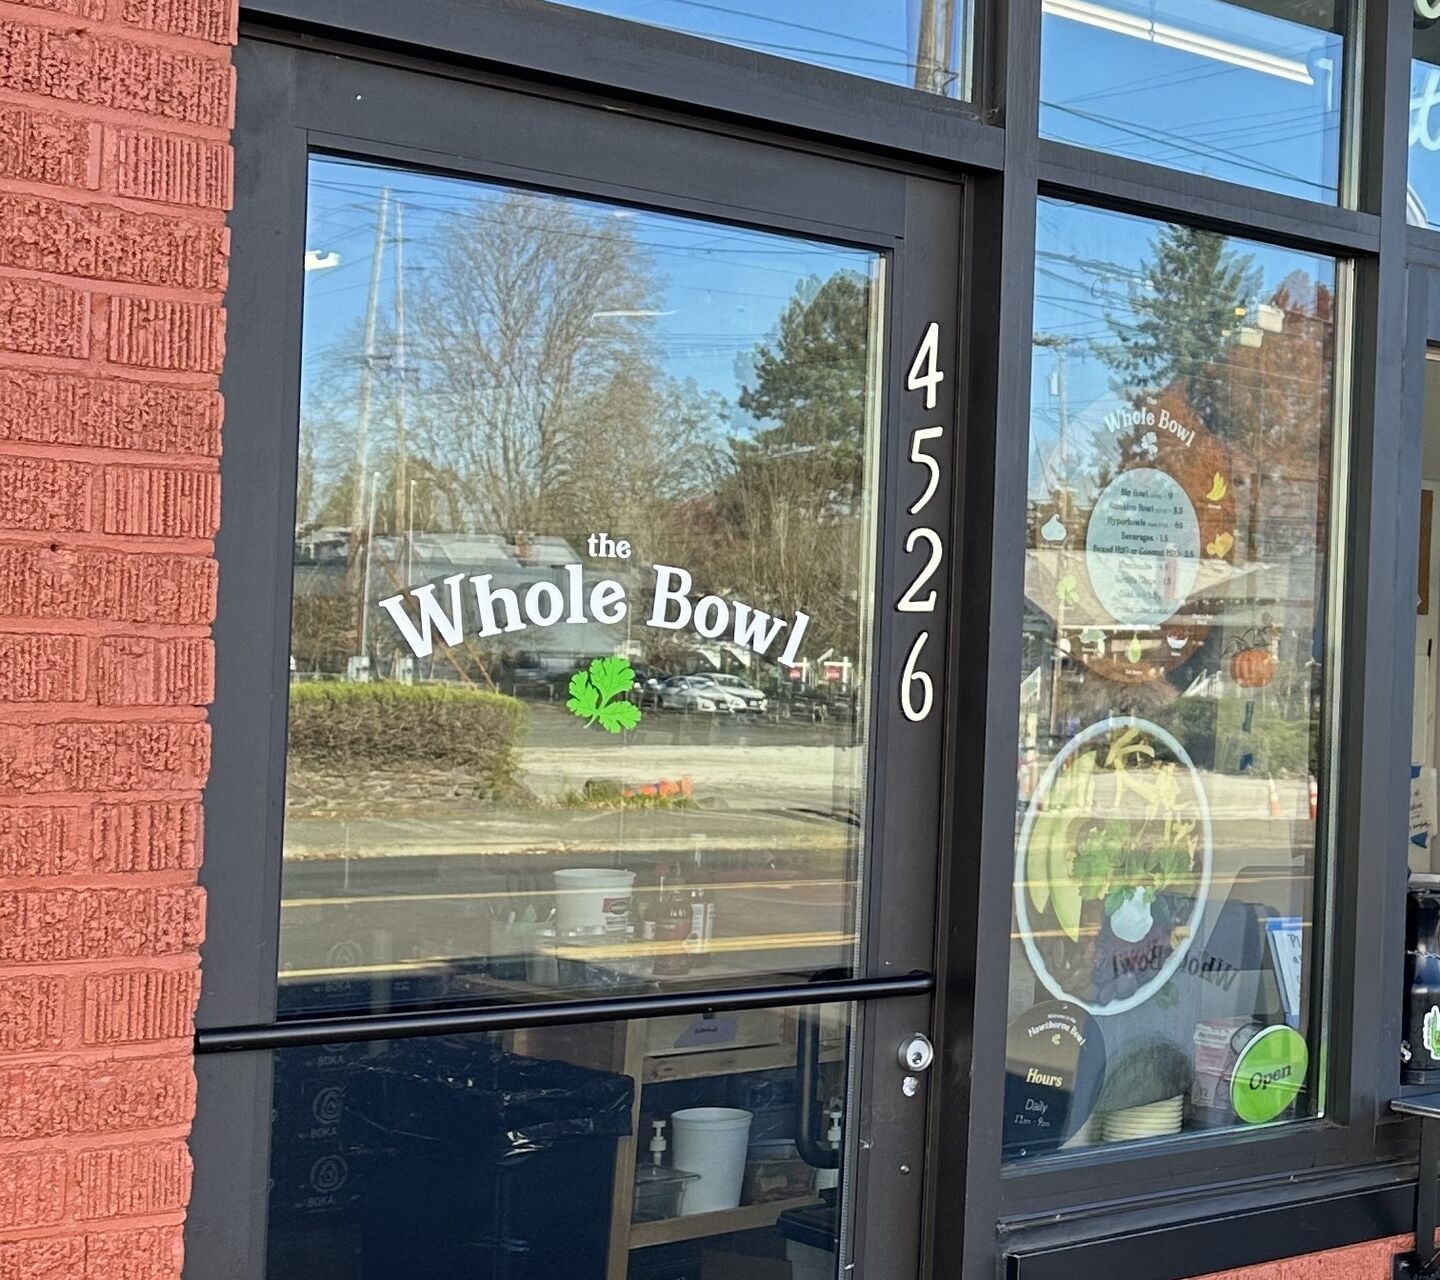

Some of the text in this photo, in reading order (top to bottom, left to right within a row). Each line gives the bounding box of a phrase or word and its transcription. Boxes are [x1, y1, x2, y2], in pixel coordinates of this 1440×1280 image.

[1103, 407, 1196, 448] Whole Bowl
[897, 322, 944, 722] 4526
[587, 533, 631, 560] the
[379, 563, 810, 669] Whole Bowl
[1028, 1020, 1087, 1046] Hawthorne Bowl
[1026, 1067, 1063, 1087] Hours
[1248, 1064, 1293, 1091] Open
[1025, 1098, 1049, 1114] Daily
